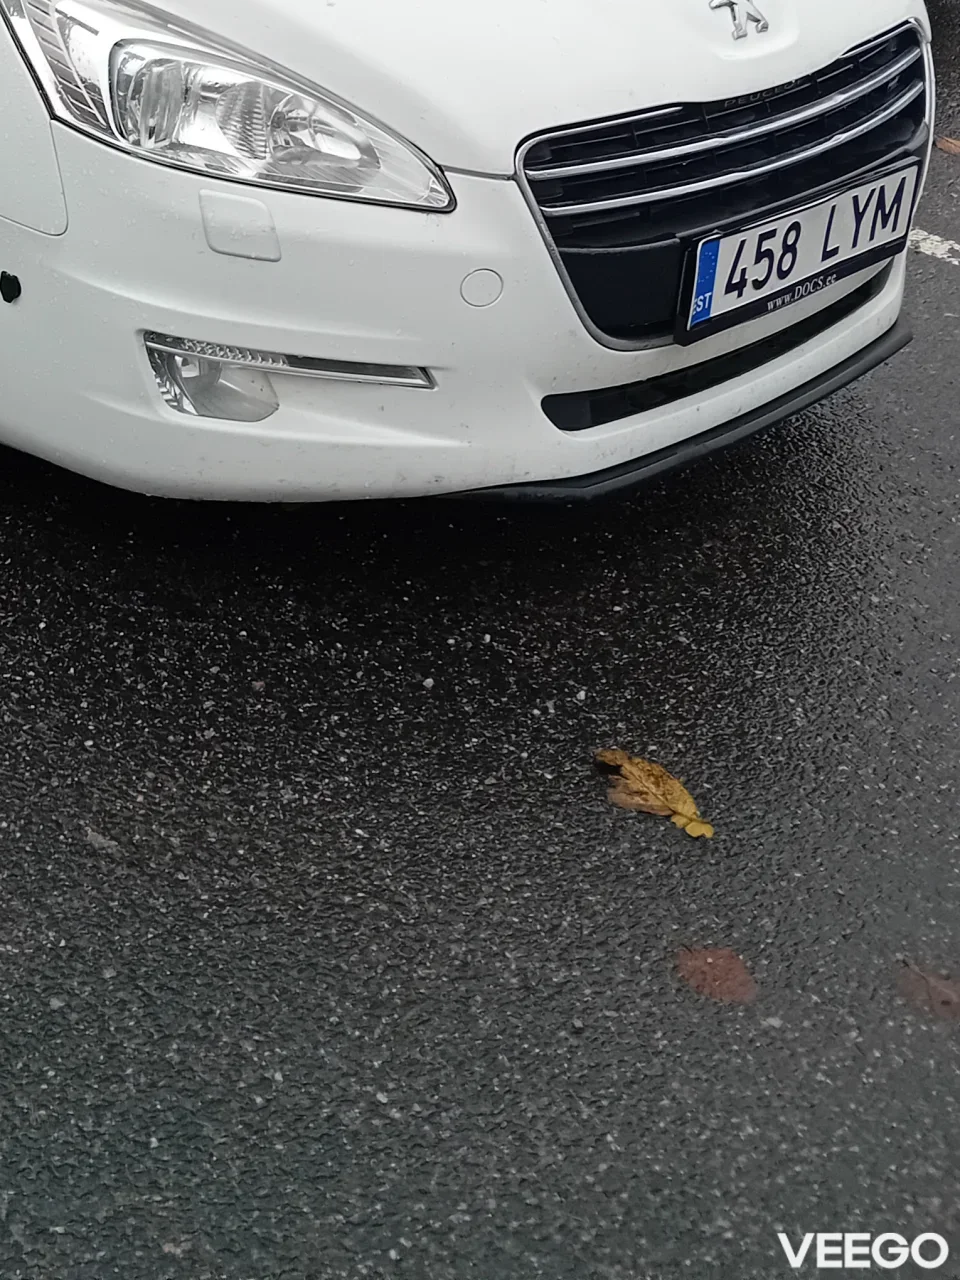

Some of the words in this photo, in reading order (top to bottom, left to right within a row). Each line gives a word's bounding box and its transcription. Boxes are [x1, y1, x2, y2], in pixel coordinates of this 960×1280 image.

[724, 221, 801, 299] 458
[820, 176, 907, 262] LYM
[767, 272, 837, 311] www.DOCS.ee
